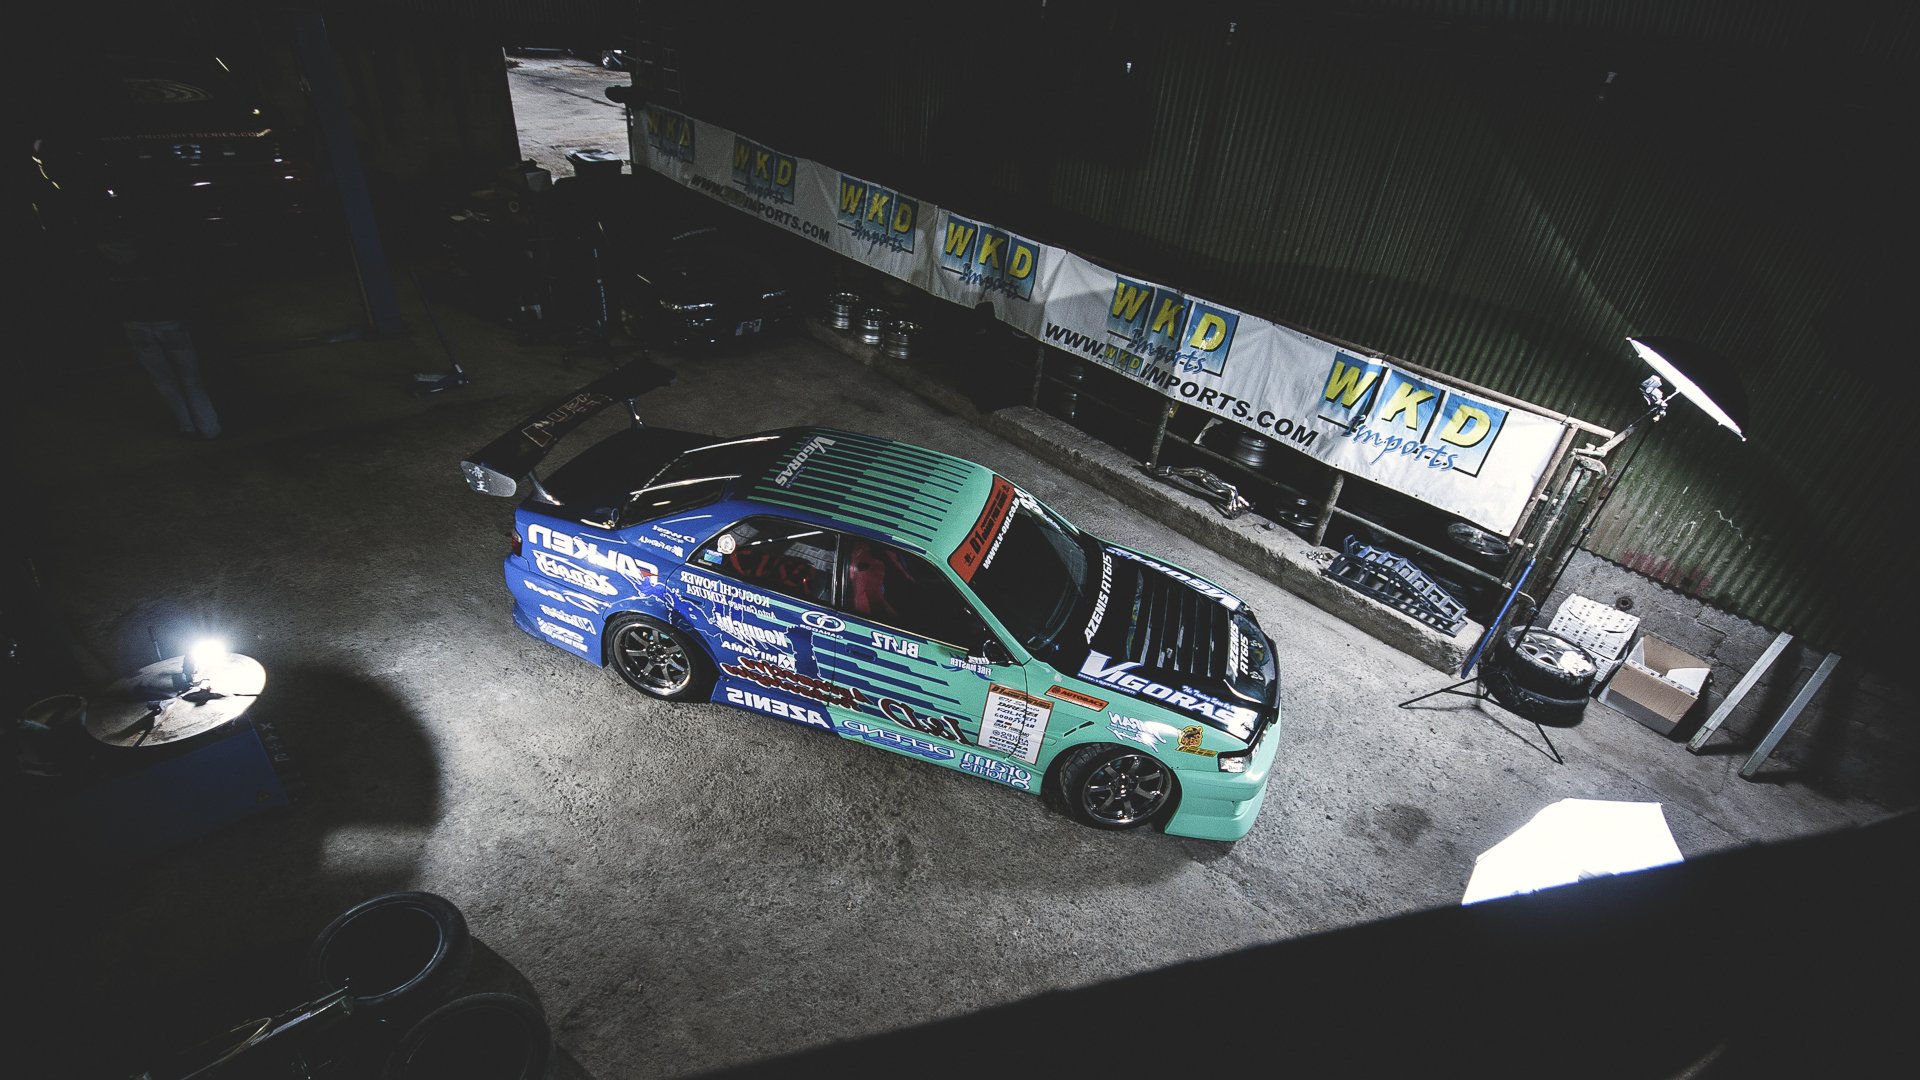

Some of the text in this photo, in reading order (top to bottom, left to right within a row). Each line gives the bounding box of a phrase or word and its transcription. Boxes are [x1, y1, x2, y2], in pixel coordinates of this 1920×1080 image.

[735, 143, 794, 187] WKD
[839, 182, 913, 234] WKD
[852, 220, 904, 255] Imports
[944, 222, 1034, 280] WKD
[959, 262, 1020, 300] Imports
[1111, 282, 1228, 352] WKD
[1126, 328, 1207, 374] Imports
[1325, 360, 1492, 449] WKD
[1342, 414, 1459, 472] Imports
[1084, 590, 1108, 645] AZENIS
[1229, 620, 1239, 676] AZENIS
[1060, 690, 1105, 708] AUTOBACS
[1080, 650, 1239, 729] VIGORAS
